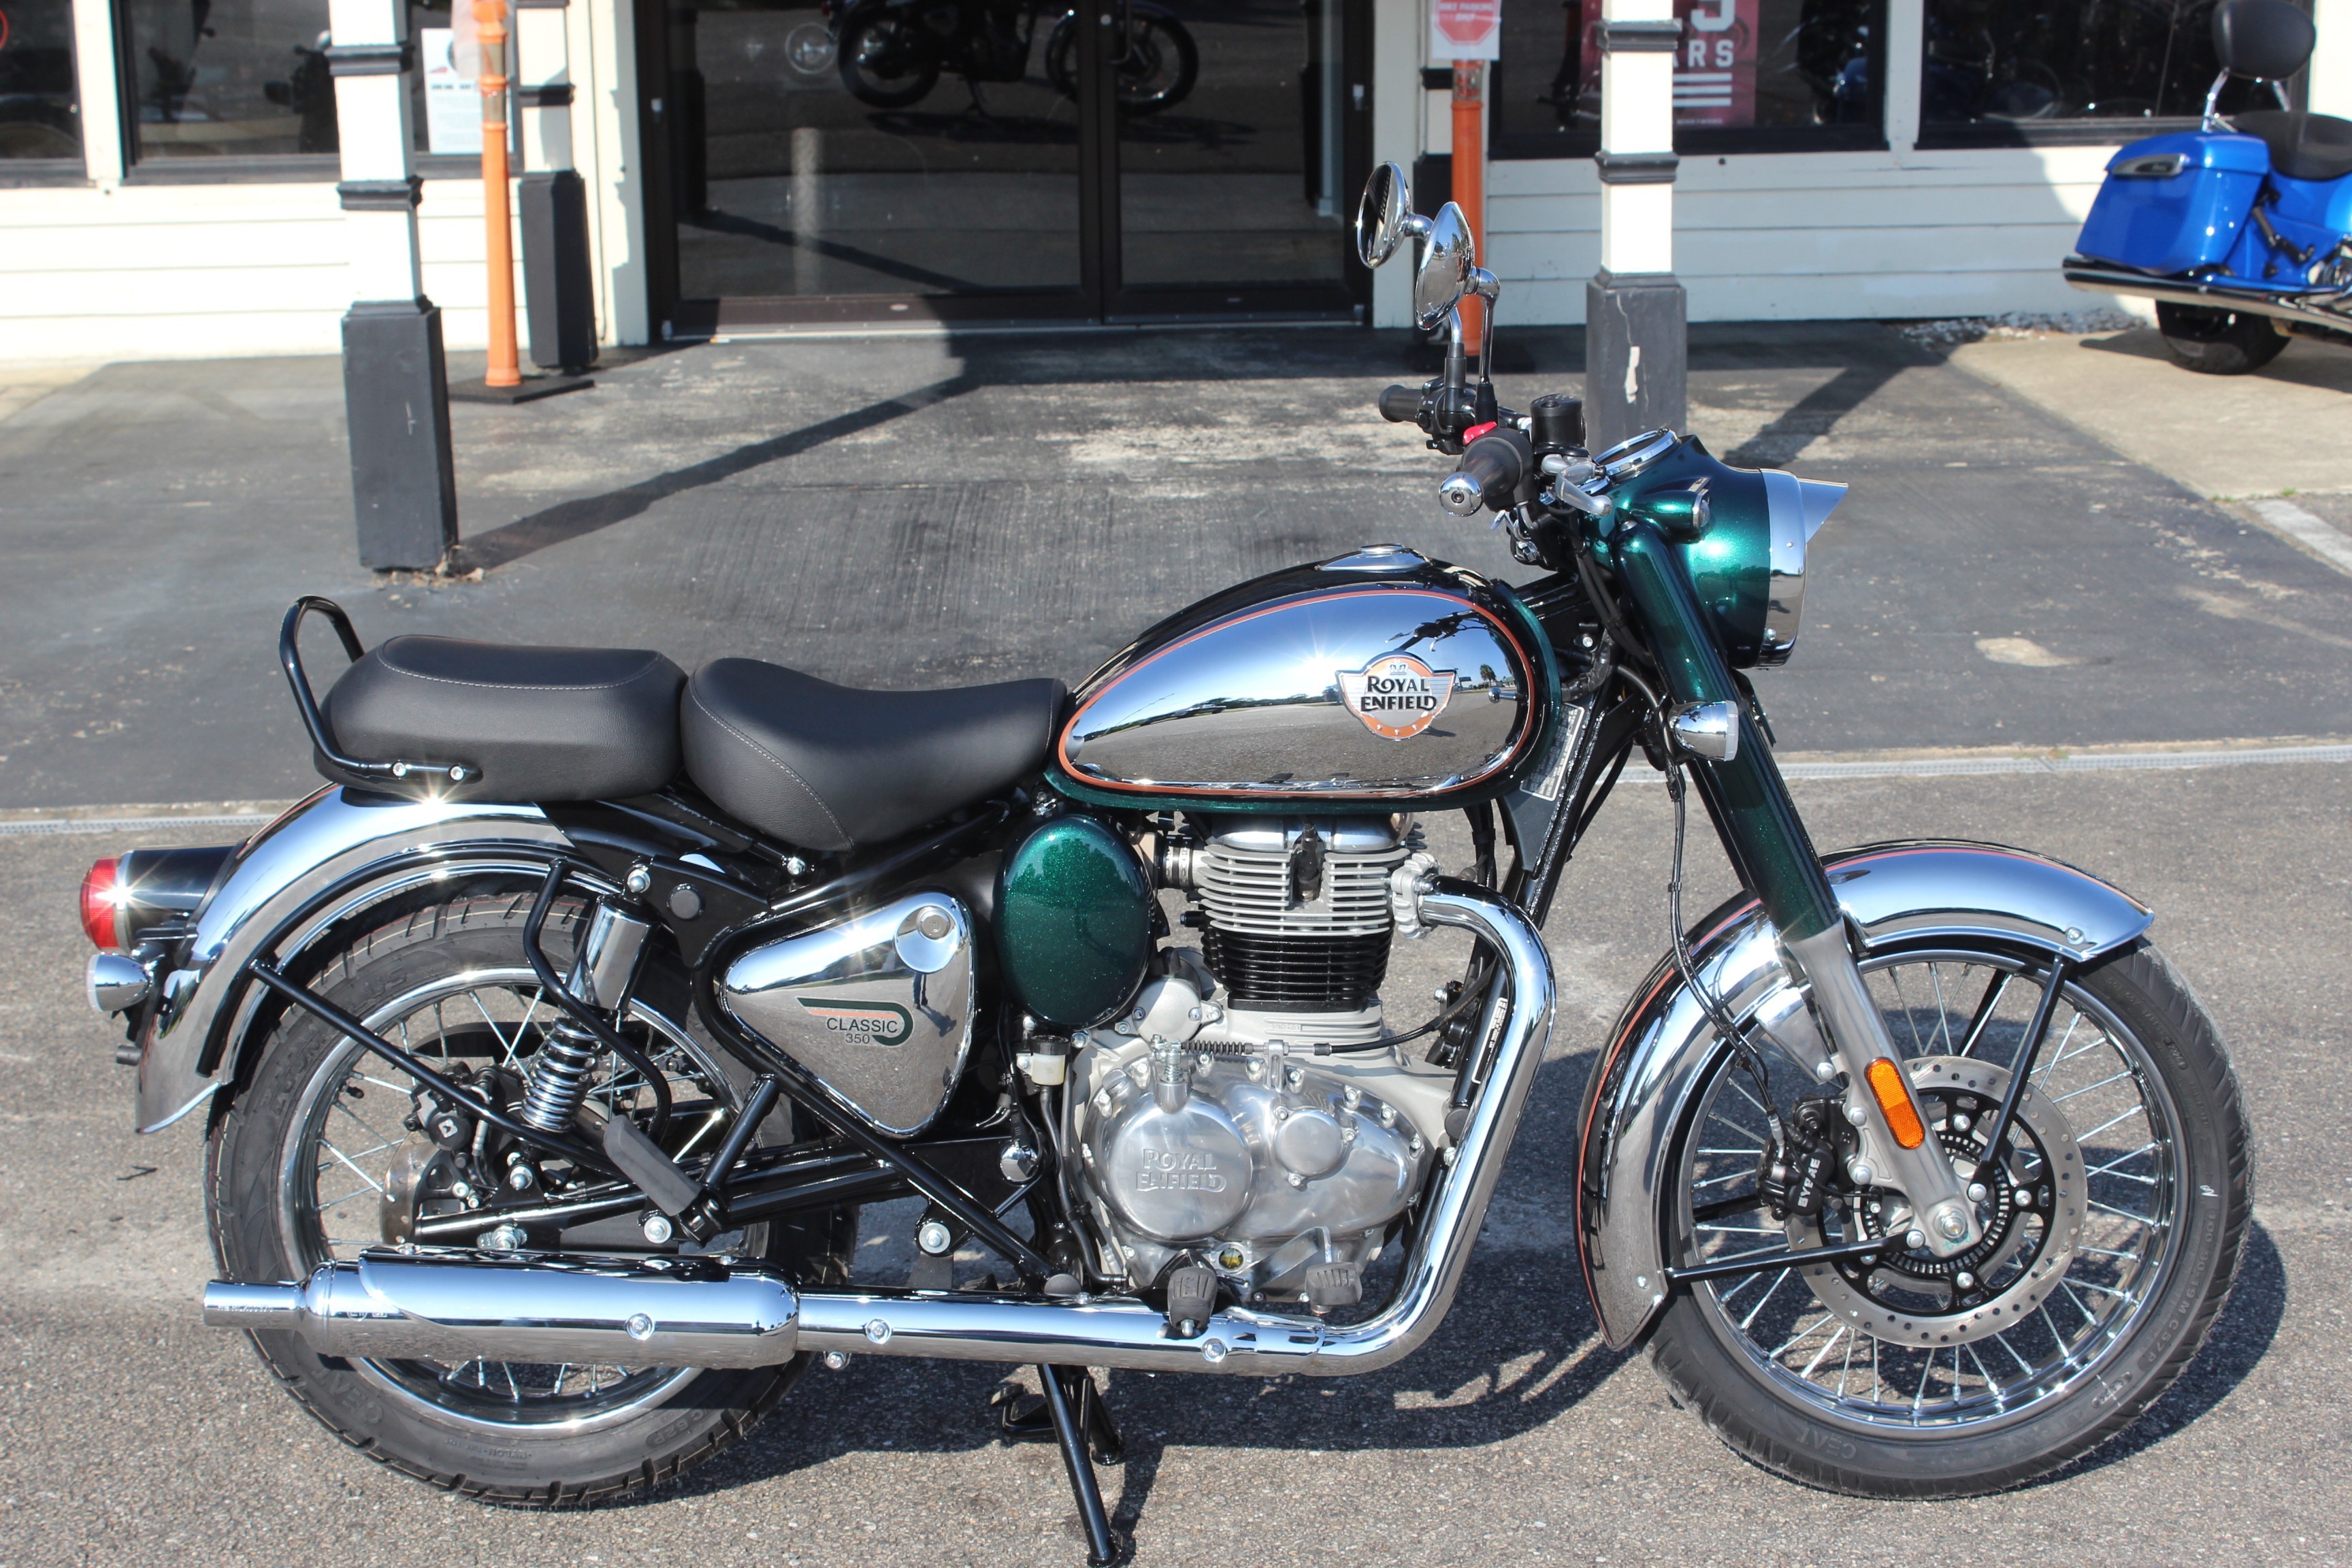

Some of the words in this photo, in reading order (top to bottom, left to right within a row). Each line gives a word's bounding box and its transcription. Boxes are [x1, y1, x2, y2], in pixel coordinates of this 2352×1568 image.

[1367, 676, 1431, 693] ROYAL
[1361, 696, 1437, 712] ENFIELD
[827, 1018, 898, 1033] CLASSIC
[845, 1034, 870, 1044] 350
[1143, 1148, 1216, 1171] ROYAL
[1137, 1172, 1226, 1192] ENFIELD
[311, 1368, 382, 1423] CEAT
[1797, 1426, 1858, 1460] CEAT
